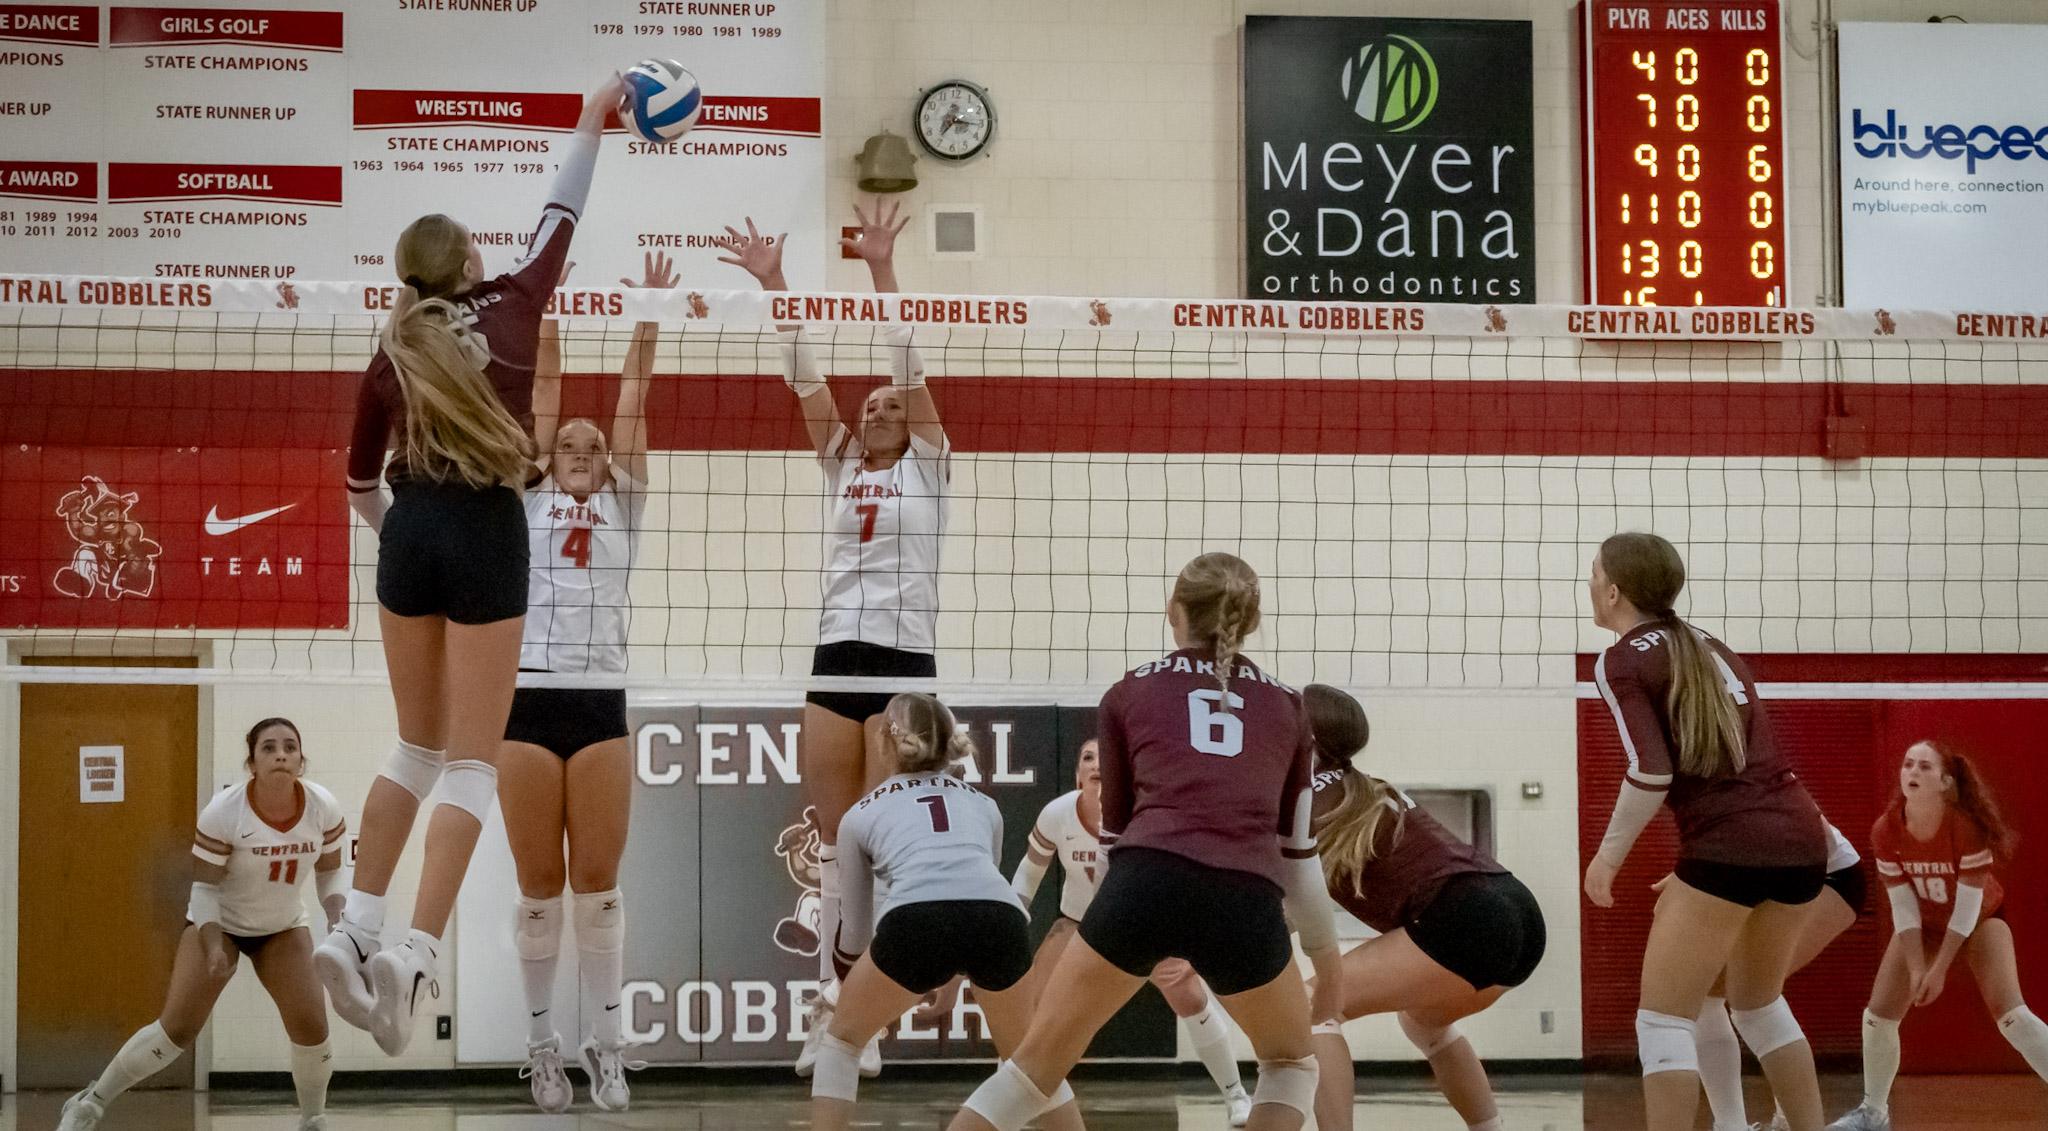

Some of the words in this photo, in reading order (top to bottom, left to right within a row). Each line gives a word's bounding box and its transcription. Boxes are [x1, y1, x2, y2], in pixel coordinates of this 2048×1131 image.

[399, 0, 444, 10] STATE
[449, 0, 512, 12] RUNNER
[516, 0, 537, 12] UP
[639, 1, 684, 15] STATE
[688, 2, 750, 16] RUNNER
[755, 4, 776, 16] UP
[14, 14, 80, 31] DANCE
[161, 17, 214, 33] GIRLS
[219, 18, 269, 35] GOLF
[1608, 8, 1650, 29] PLYR
[1666, 9, 1709, 30] ACES
[1721, 9, 1766, 30] KILLS
[593, 24, 624, 35] 1978
[634, 25, 664, 36] 1979
[673, 26, 703, 36] 1980
[713, 26, 742, 37] 1981
[752, 27, 782, 38] 1989
[144, 55, 196, 69] STATE
[201, 56, 308, 72] CHAMPIONS
[1632, 50, 1655, 81] 4
[1675, 48, 1698, 85] 0
[1746, 49, 1769, 86] 0
[30, 103, 52, 116] UP
[156, 105, 202, 119] STATE
[206, 106, 271, 120] RUNNER
[275, 107, 296, 121] UP
[415, 99, 523, 117] WRESTLING
[702, 105, 768, 121] TENNIS
[1637, 94, 1656, 128] 7
[1676, 94, 1699, 132] 0
[1747, 95, 1770, 133] 0
[387, 137, 438, 151] STATE
[443, 138, 549, 153] CHAMPIONS
[628, 141, 678, 155] STATE
[682, 142, 788, 157] CHAMPIONS
[353, 160, 383, 171] 1963
[394, 161, 424, 172] 1964
[433, 161, 463, 172] 1965
[474, 162, 504, 173] 1977
[513, 163, 544, 174] 1978
[1634, 144, 1658, 178] 9
[1677, 144, 1700, 182] 0
[1748, 145, 1771, 182] 6
[8, 170, 79, 187] AWARD
[1264, 141, 1514, 203] Meyer
[177, 173, 273, 190] SOFTBALL
[1854, 177, 1910, 192] Around
[1914, 178, 1954, 193] here,
[1958, 179, 2044, 193] connection
[1621, 193, 1659, 225] 11
[1678, 190, 1701, 228] 0
[1749, 191, 1772, 229] 0
[1852, 199, 1988, 216] mybluepeak.com
[25, 211, 57, 222] 1989
[66, 212, 98, 223] 1994
[143, 210, 194, 225] STATE
[200, 211, 307, 226] CHAMPIONS
[24, 225, 55, 236] 2011
[66, 226, 98, 237] 2012
[107, 228, 139, 238] 2003
[149, 228, 181, 239] 2010
[472, 232, 513, 246] NNER
[638, 234, 682, 247] STATE
[353, 254, 384, 265] 1968
[1623, 240, 1660, 279] 13
[1679, 240, 1702, 279] 0
[1750, 241, 1774, 279] 0
[155, 264, 200, 278] STATE
[205, 265, 270, 279] RUNNER
[274, 266, 295, 279] UP
[1264, 269, 1521, 297] orthodontics
[79, 281, 212, 307] COBBLERS
[545, 292, 623, 316] BLERS
[772, 297, 889, 322] CENTRAL
[899, 299, 1028, 324] COBBLERS
[1174, 304, 1289, 328] CENTRAL
[1299, 306, 1425, 331] COBBLERS
[1568, 311, 1681, 334] CENTRAL
[1691, 311, 1815, 335] COBBLERS
[855, 504, 879, 544] 7
[561, 527, 588, 568] 4
[201, 557, 303, 577] TEAM
[1187, 688, 1244, 758] 6
[637, 723, 1034, 784] CENAL
[859, 777, 979, 810] SPARTAN
[915, 794, 950, 833] 1
[268, 859, 299, 885] 11
